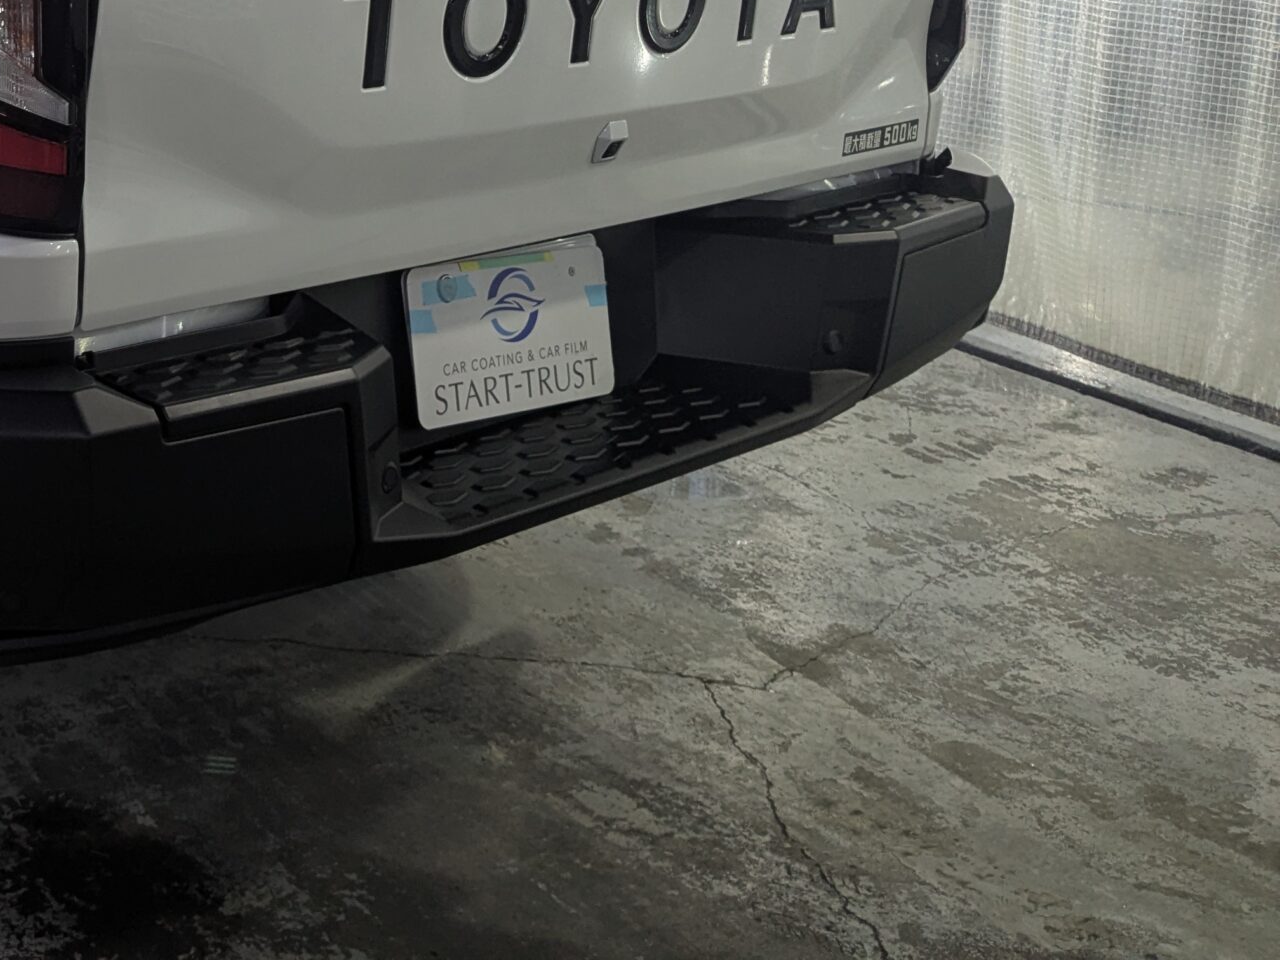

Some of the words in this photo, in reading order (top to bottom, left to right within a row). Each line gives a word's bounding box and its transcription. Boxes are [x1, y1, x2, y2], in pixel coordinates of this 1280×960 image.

[884, 122, 918, 145] 500kg
[443, 361, 467, 376] CAR
[471, 352, 523, 371] COATING
[527, 349, 535, 362] &
[539, 344, 560, 360] CAR
[564, 340, 588, 355] FILM
[434, 357, 599, 416] START-TRUST
